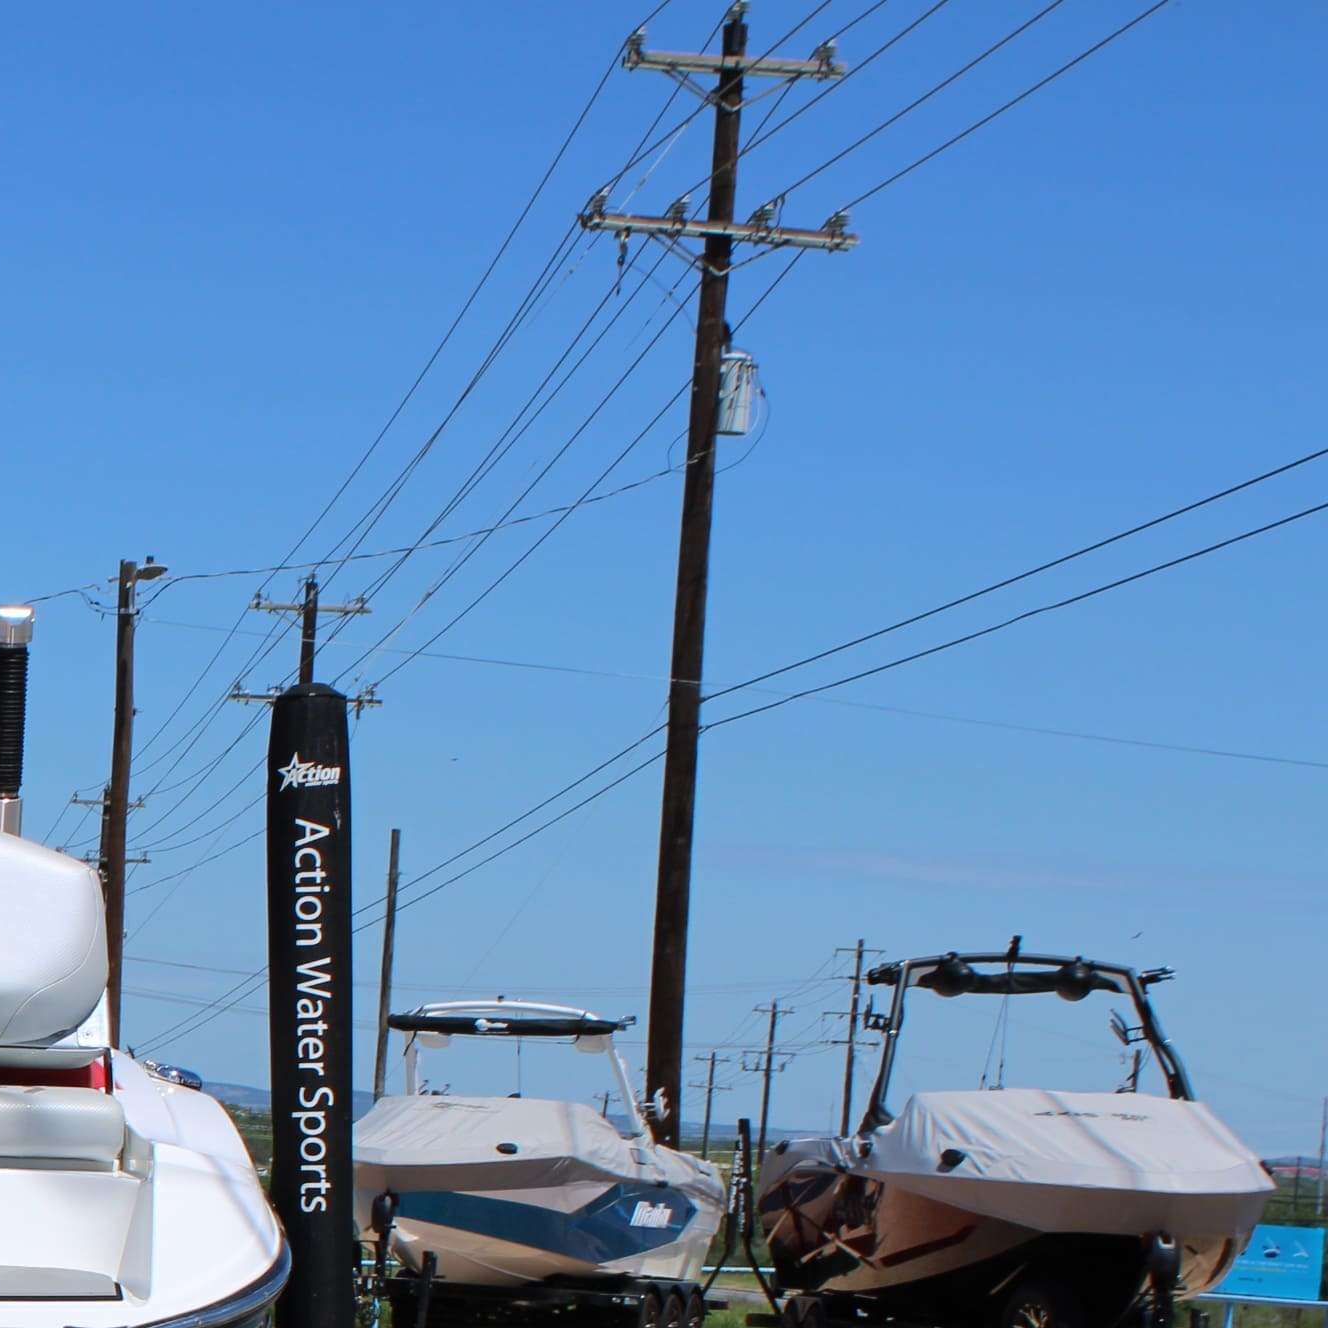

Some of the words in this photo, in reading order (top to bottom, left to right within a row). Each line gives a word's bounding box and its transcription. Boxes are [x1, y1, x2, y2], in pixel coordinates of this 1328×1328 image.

[279, 760, 341, 791] Action
[294, 817, 331, 946] Action
[296, 956, 332, 1076] Water
[291, 1086, 334, 1213] Sports
